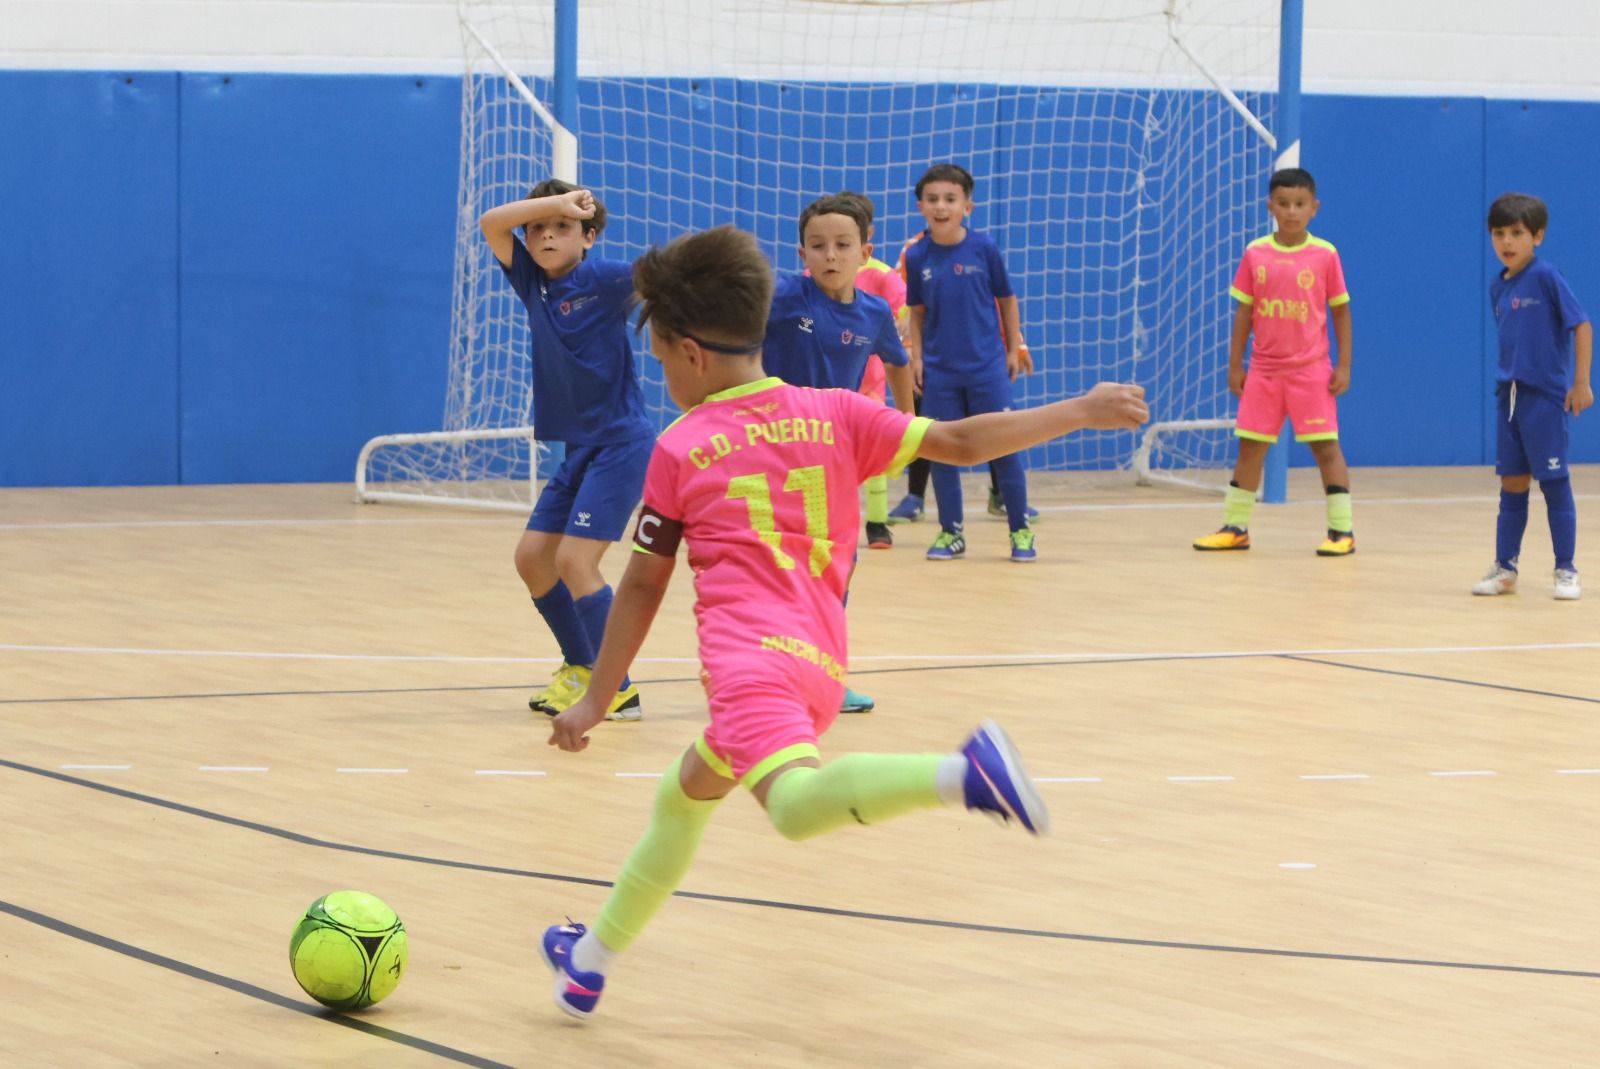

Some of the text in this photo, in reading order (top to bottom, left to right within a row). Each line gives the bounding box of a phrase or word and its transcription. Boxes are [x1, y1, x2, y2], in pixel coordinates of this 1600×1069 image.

[688, 417, 835, 470] C.D. PUERTO
[638, 514, 662, 545] C
[724, 464, 834, 577] 11
